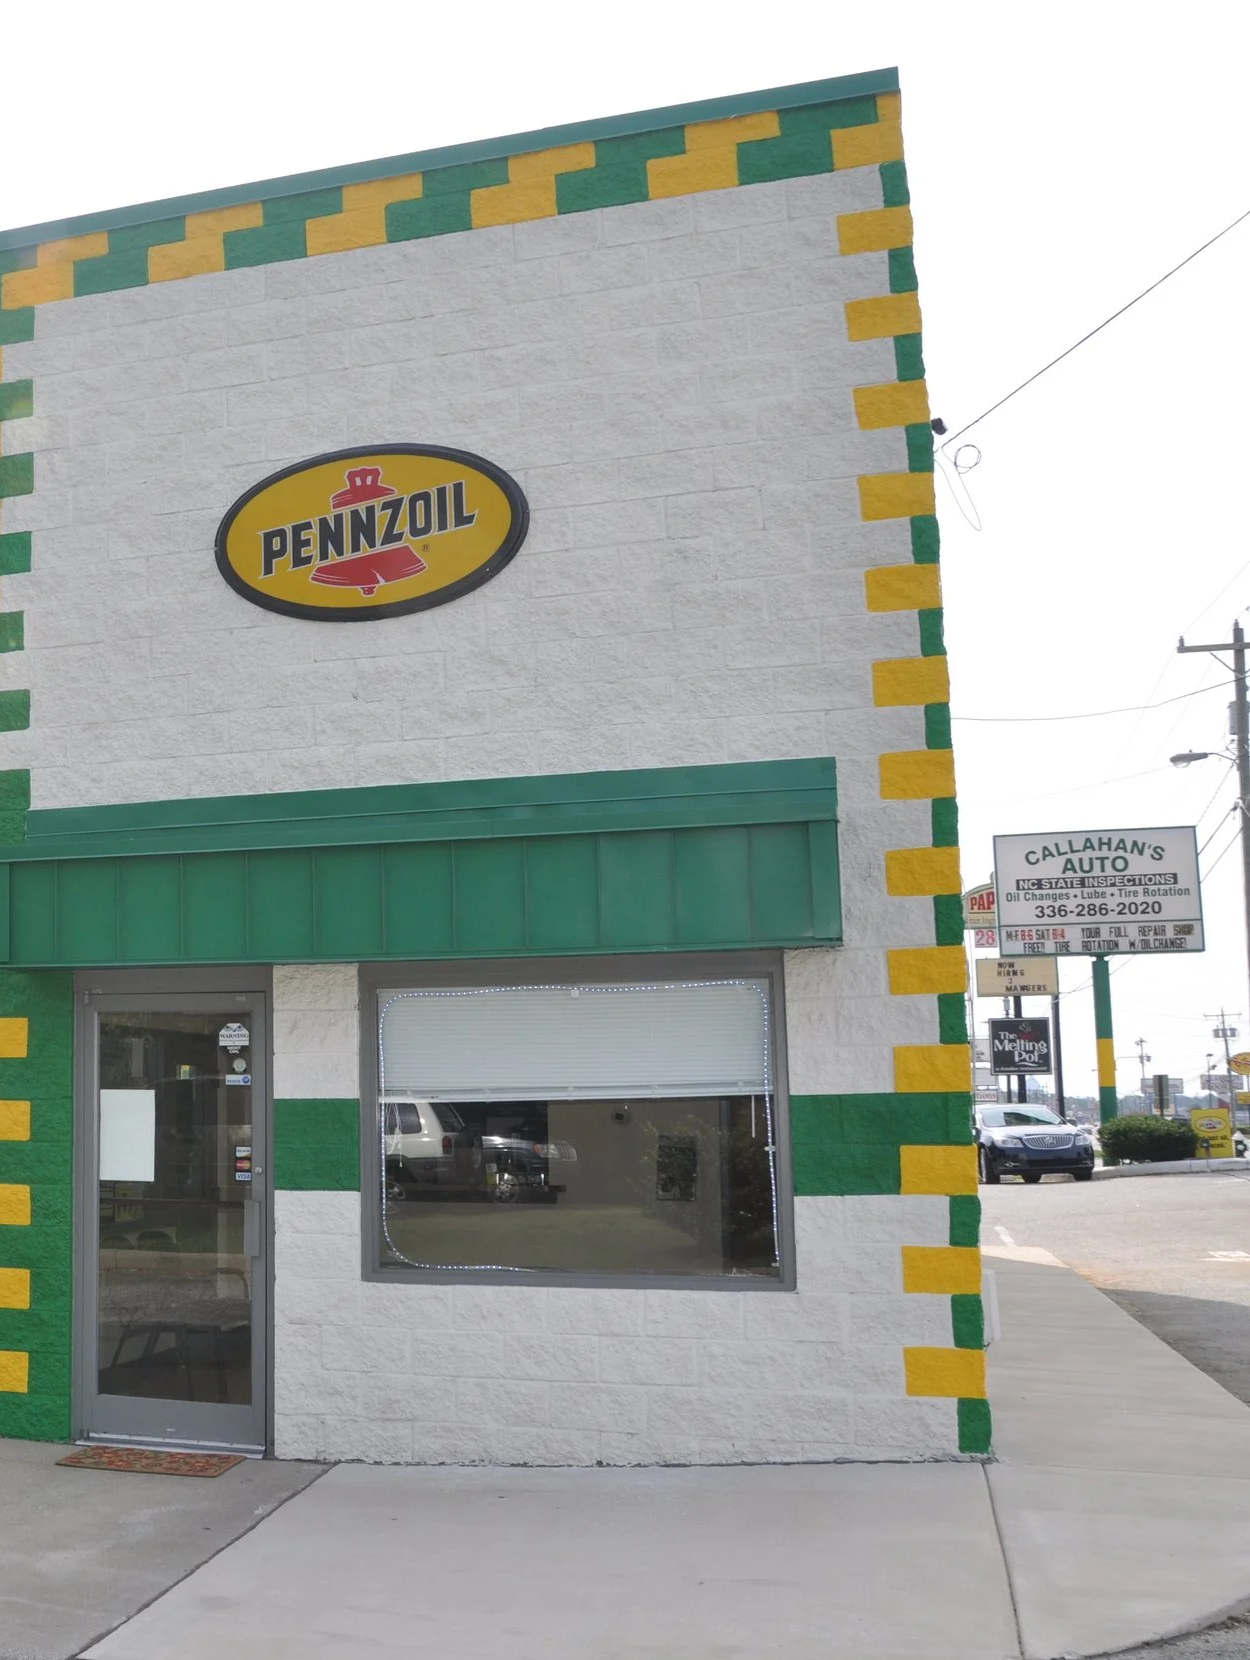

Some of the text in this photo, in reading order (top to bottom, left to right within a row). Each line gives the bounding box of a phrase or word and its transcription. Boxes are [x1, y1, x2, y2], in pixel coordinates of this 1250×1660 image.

[259, 480, 478, 578] PENNZOIL
[1025, 837, 1165, 866] CALLAHAN'S
[1062, 856, 1129, 874] AUTO
[1019, 874, 1175, 890] NC STATE INSPECTIONS
[1006, 886, 1190, 903] Oil Changes Lube Tire Rotation
[1035, 901, 1162, 918] 336-286-2020
[1081, 927, 1101, 939] YOUR
[1109, 926, 1129, 938] FULL
[1138, 925, 1166, 937] REPAIR
[1054, 941, 1070, 952] TIRE
[1081, 939, 1119, 952] ROTATION
[998, 1031, 1017, 1040] The
[994, 1040, 1048, 1054] Melting
[1014, 1050, 1039, 1062] Pot
